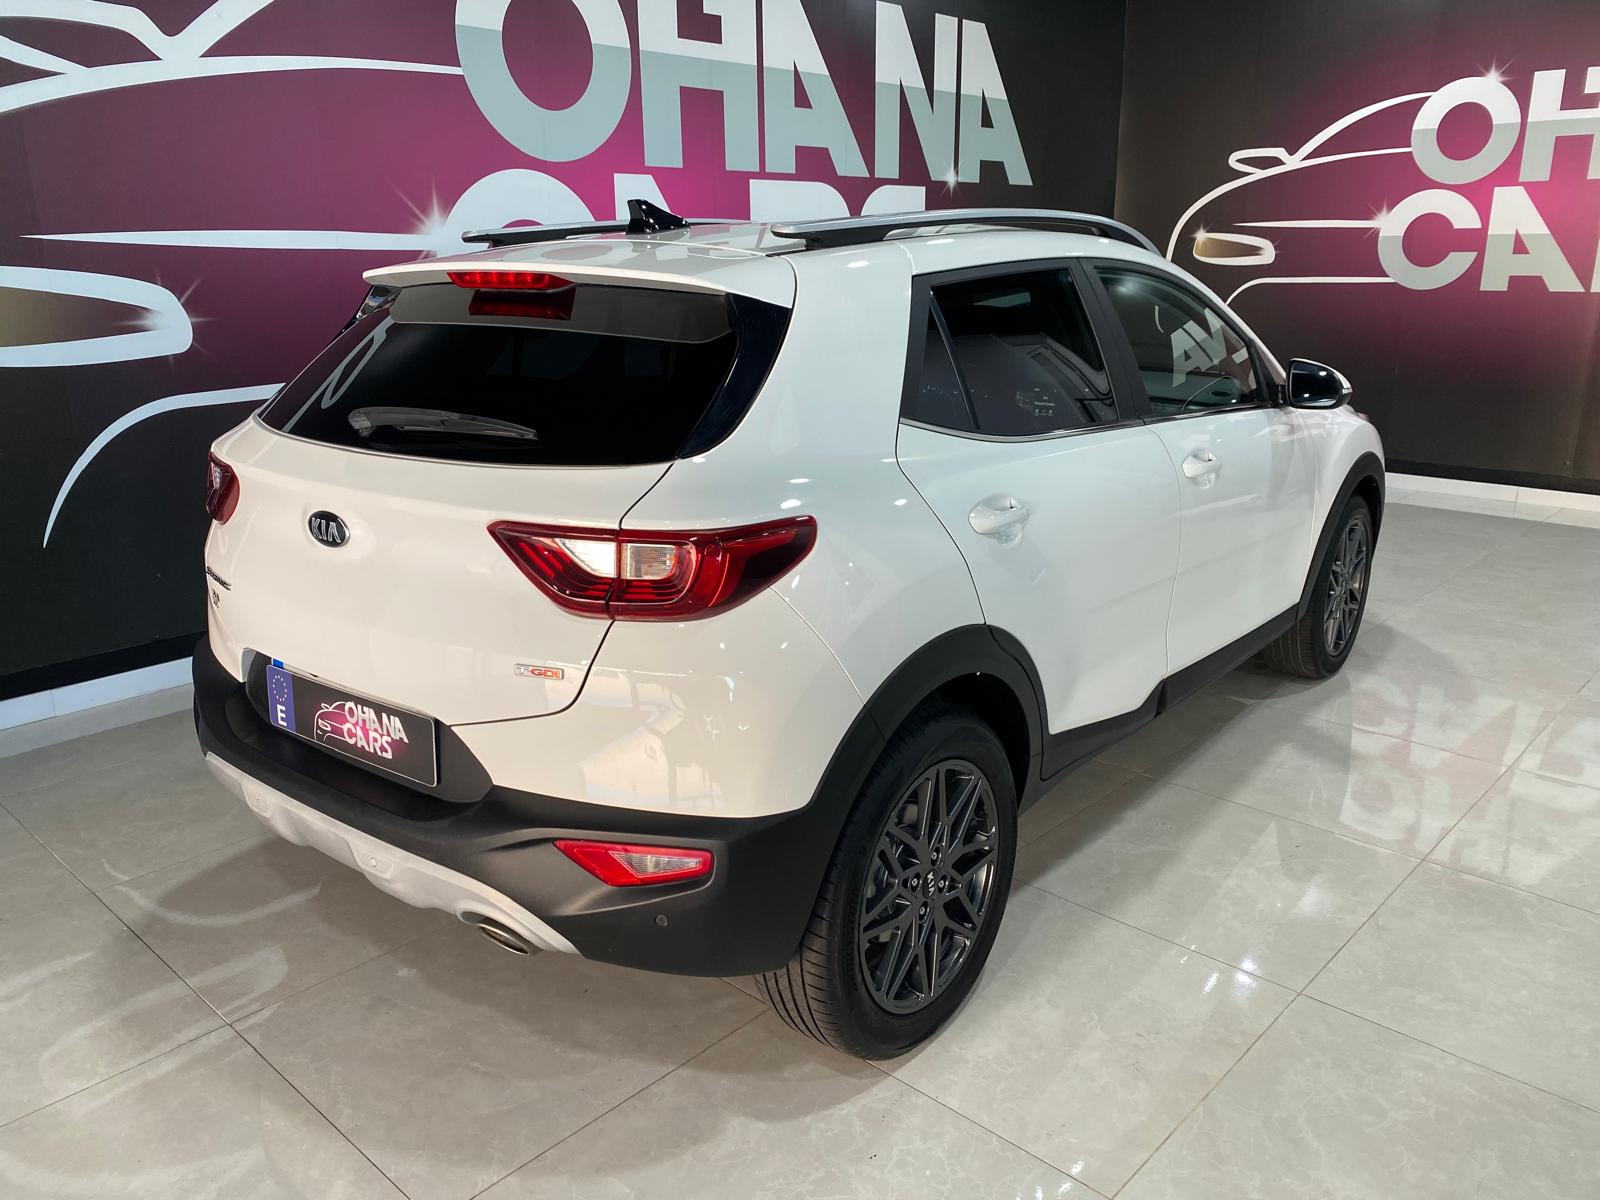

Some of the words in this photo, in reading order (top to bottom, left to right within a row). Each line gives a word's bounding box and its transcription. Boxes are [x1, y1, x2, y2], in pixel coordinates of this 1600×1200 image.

[455, 0, 1033, 187] OHANA
[1378, 186, 1600, 292] CA
[311, 517, 341, 543] KIA
[276, 704, 287, 727] E
[344, 701, 409, 744] OHANA
[343, 722, 393, 759] CARS
